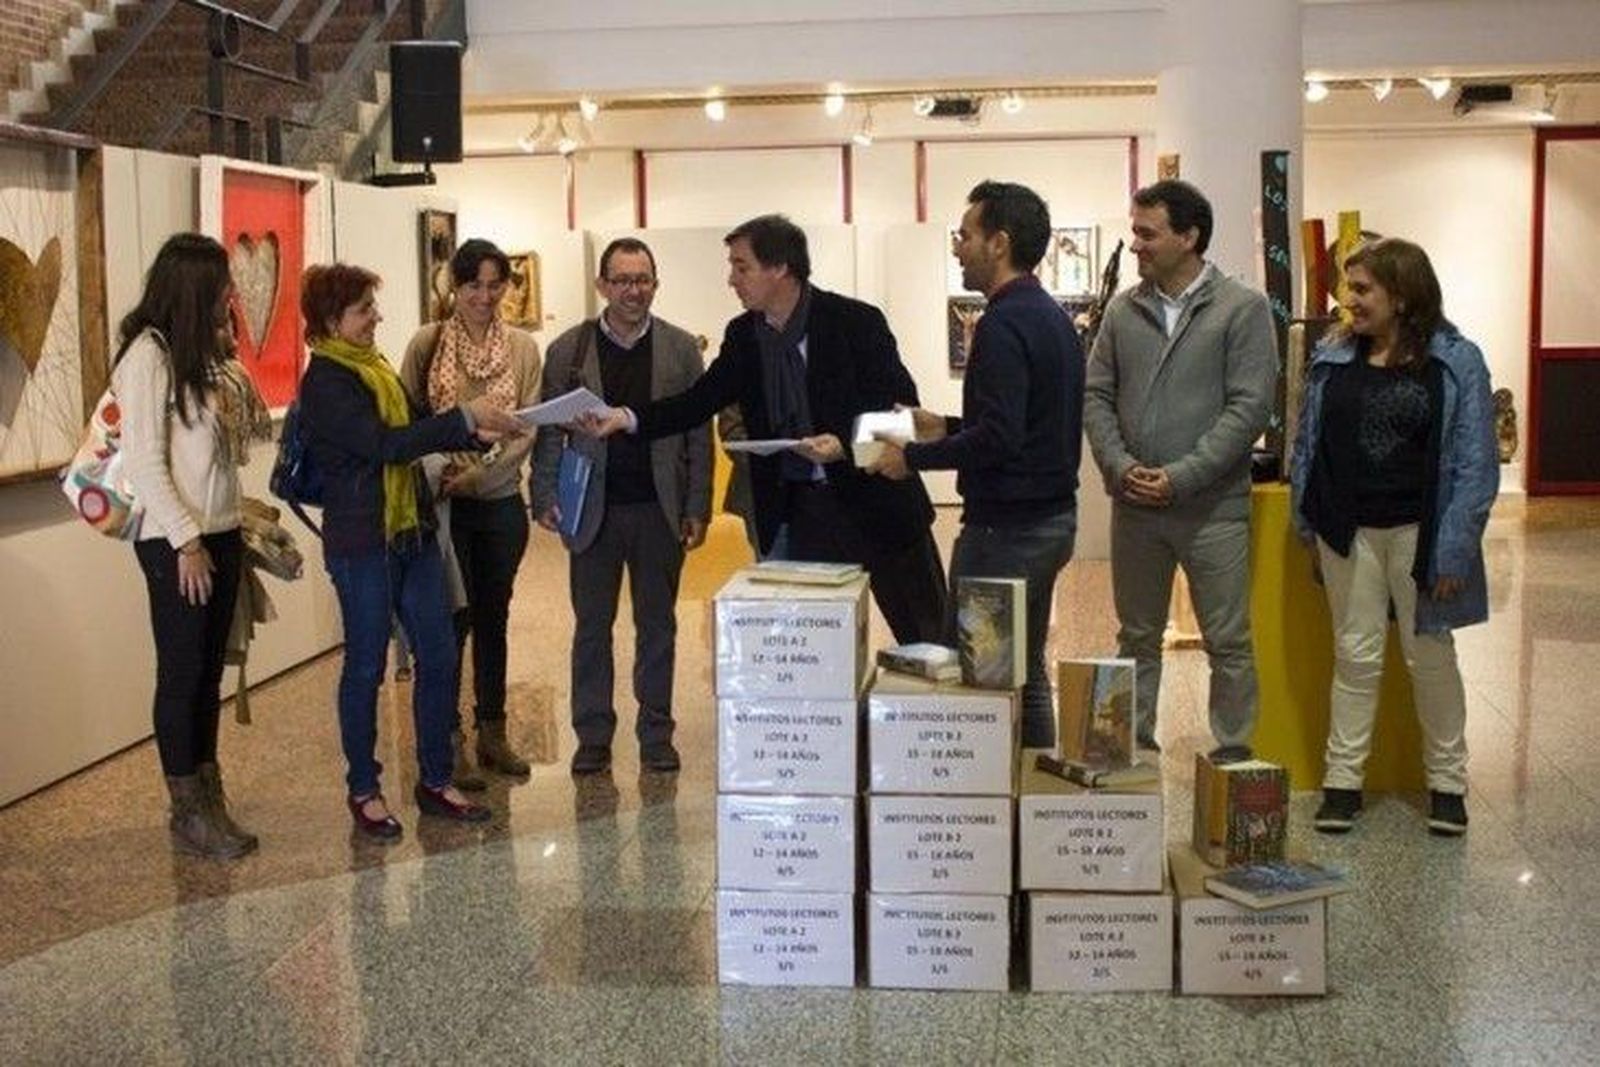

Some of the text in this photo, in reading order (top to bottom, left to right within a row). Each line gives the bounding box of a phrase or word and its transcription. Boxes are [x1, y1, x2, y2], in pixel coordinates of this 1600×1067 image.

[732, 618, 842, 629] NSTITUTS LECTORES
[763, 635, 787, 646] LOTE
[791, 635, 798, 646] A
[790, 654, 819, 664] AÑOS
[735, 714, 842, 726] NSTITUTOS LECTORES
[884, 712, 996, 723] INTITUTOS LECTORES
[765, 733, 788, 741] LOTE
[792, 733, 798, 741] A
[919, 731, 943, 740] LOTE
[791, 750, 820, 760] AÑOS
[946, 749, 974, 759] AÑOS
[791, 813, 839, 823] ECTORES
[884, 814, 996, 824] INSTITUTOS LECTORES
[1034, 810, 1148, 820] INSTITUTOS LECTORES
[790, 832, 798, 841] A
[918, 833, 942, 842] LOTE
[1069, 828, 1094, 838] LOTE
[753, 848, 764, 858] 12
[790, 848, 818, 858] AÑOS
[945, 850, 974, 860] AÑOS
[1058, 846, 1069, 856] 15
[1097, 845, 1125, 856] AÑOS
[790, 909, 839, 919] LECTORES
[946, 911, 996, 921] LECTORES
[1045, 913, 1158, 923] INSTITUTOS LECTORES
[1194, 915, 1309, 926] INSTITUTOS LECTORES
[763, 927, 786, 936] LOTE
[791, 927, 798, 936] A
[918, 928, 942, 938] LOTE
[1080, 932, 1104, 941] LOTE
[1230, 934, 1255, 943] LOTE
[791, 944, 818, 953] AÑOS
[945, 945, 973, 956] AÑOS
[1107, 949, 1137, 960] AÑOS
[1258, 951, 1287, 960] AÑOS
